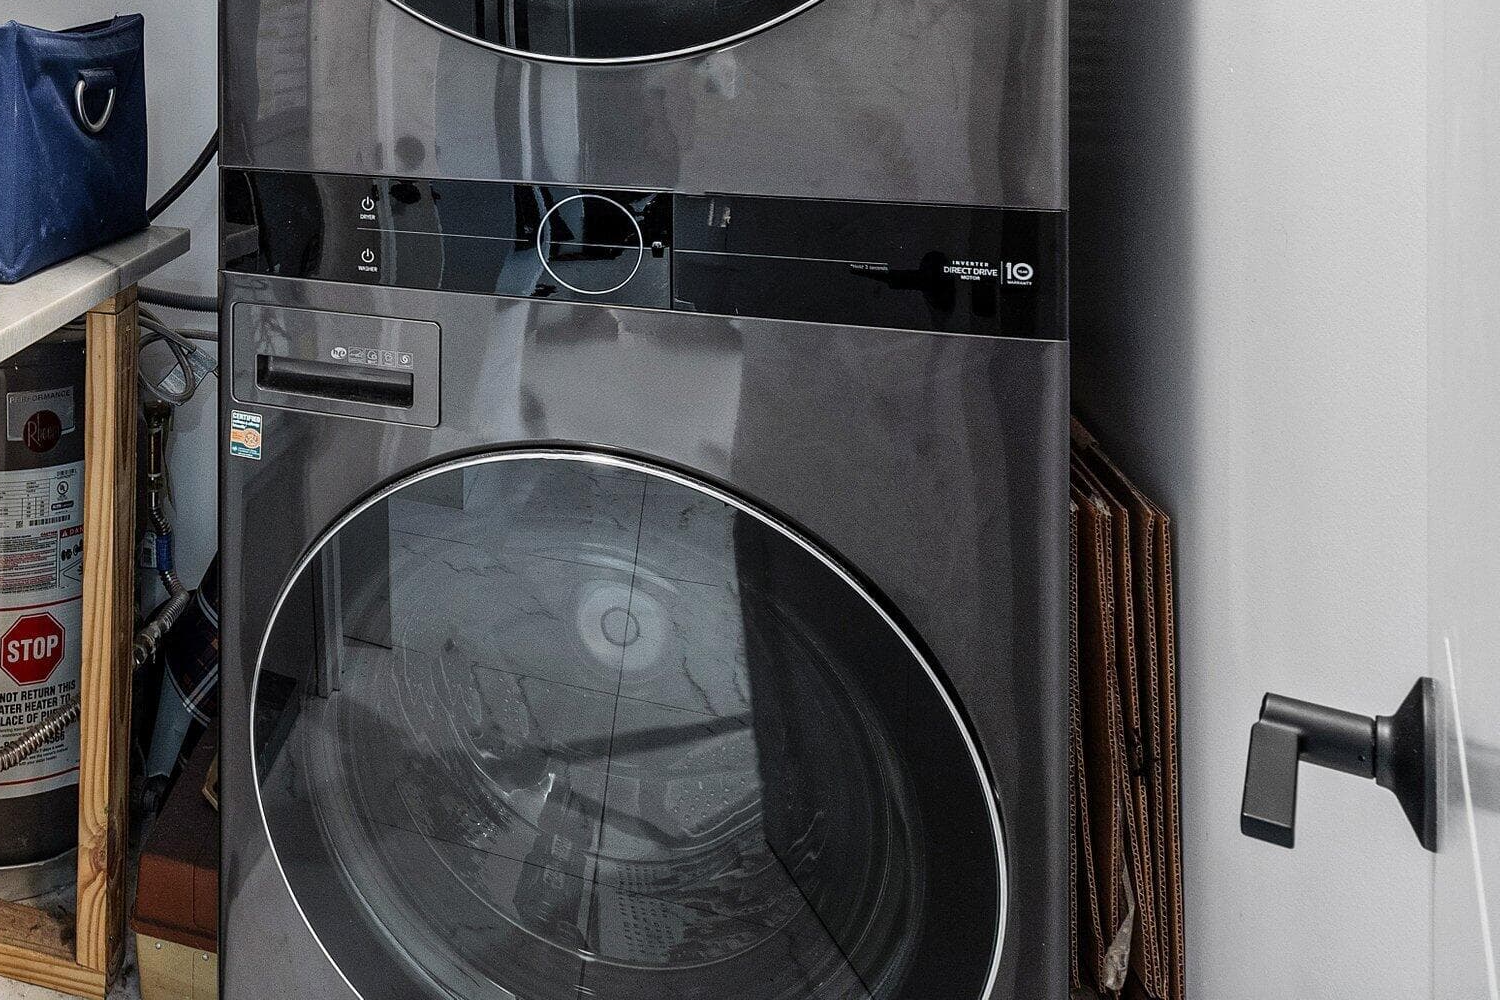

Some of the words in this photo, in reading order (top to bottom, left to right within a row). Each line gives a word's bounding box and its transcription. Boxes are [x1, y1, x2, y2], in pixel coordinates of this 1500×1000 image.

[944, 266, 977, 275] DIRECT
[977, 267, 998, 277] DRIVE
[1005, 262, 1034, 280] 10
[9, 390, 70, 404] PERFORMANCE
[69, 525, 84, 535] DAN
[7, 634, 59, 663] STOP
[0, 691, 18, 704] NOT
[21, 687, 56, 701] RETURN
[58, 680, 76, 694] THIS
[25, 698, 58, 712] HEATER
[61, 693, 70, 704] TO
[27, 713, 38, 724] OF
